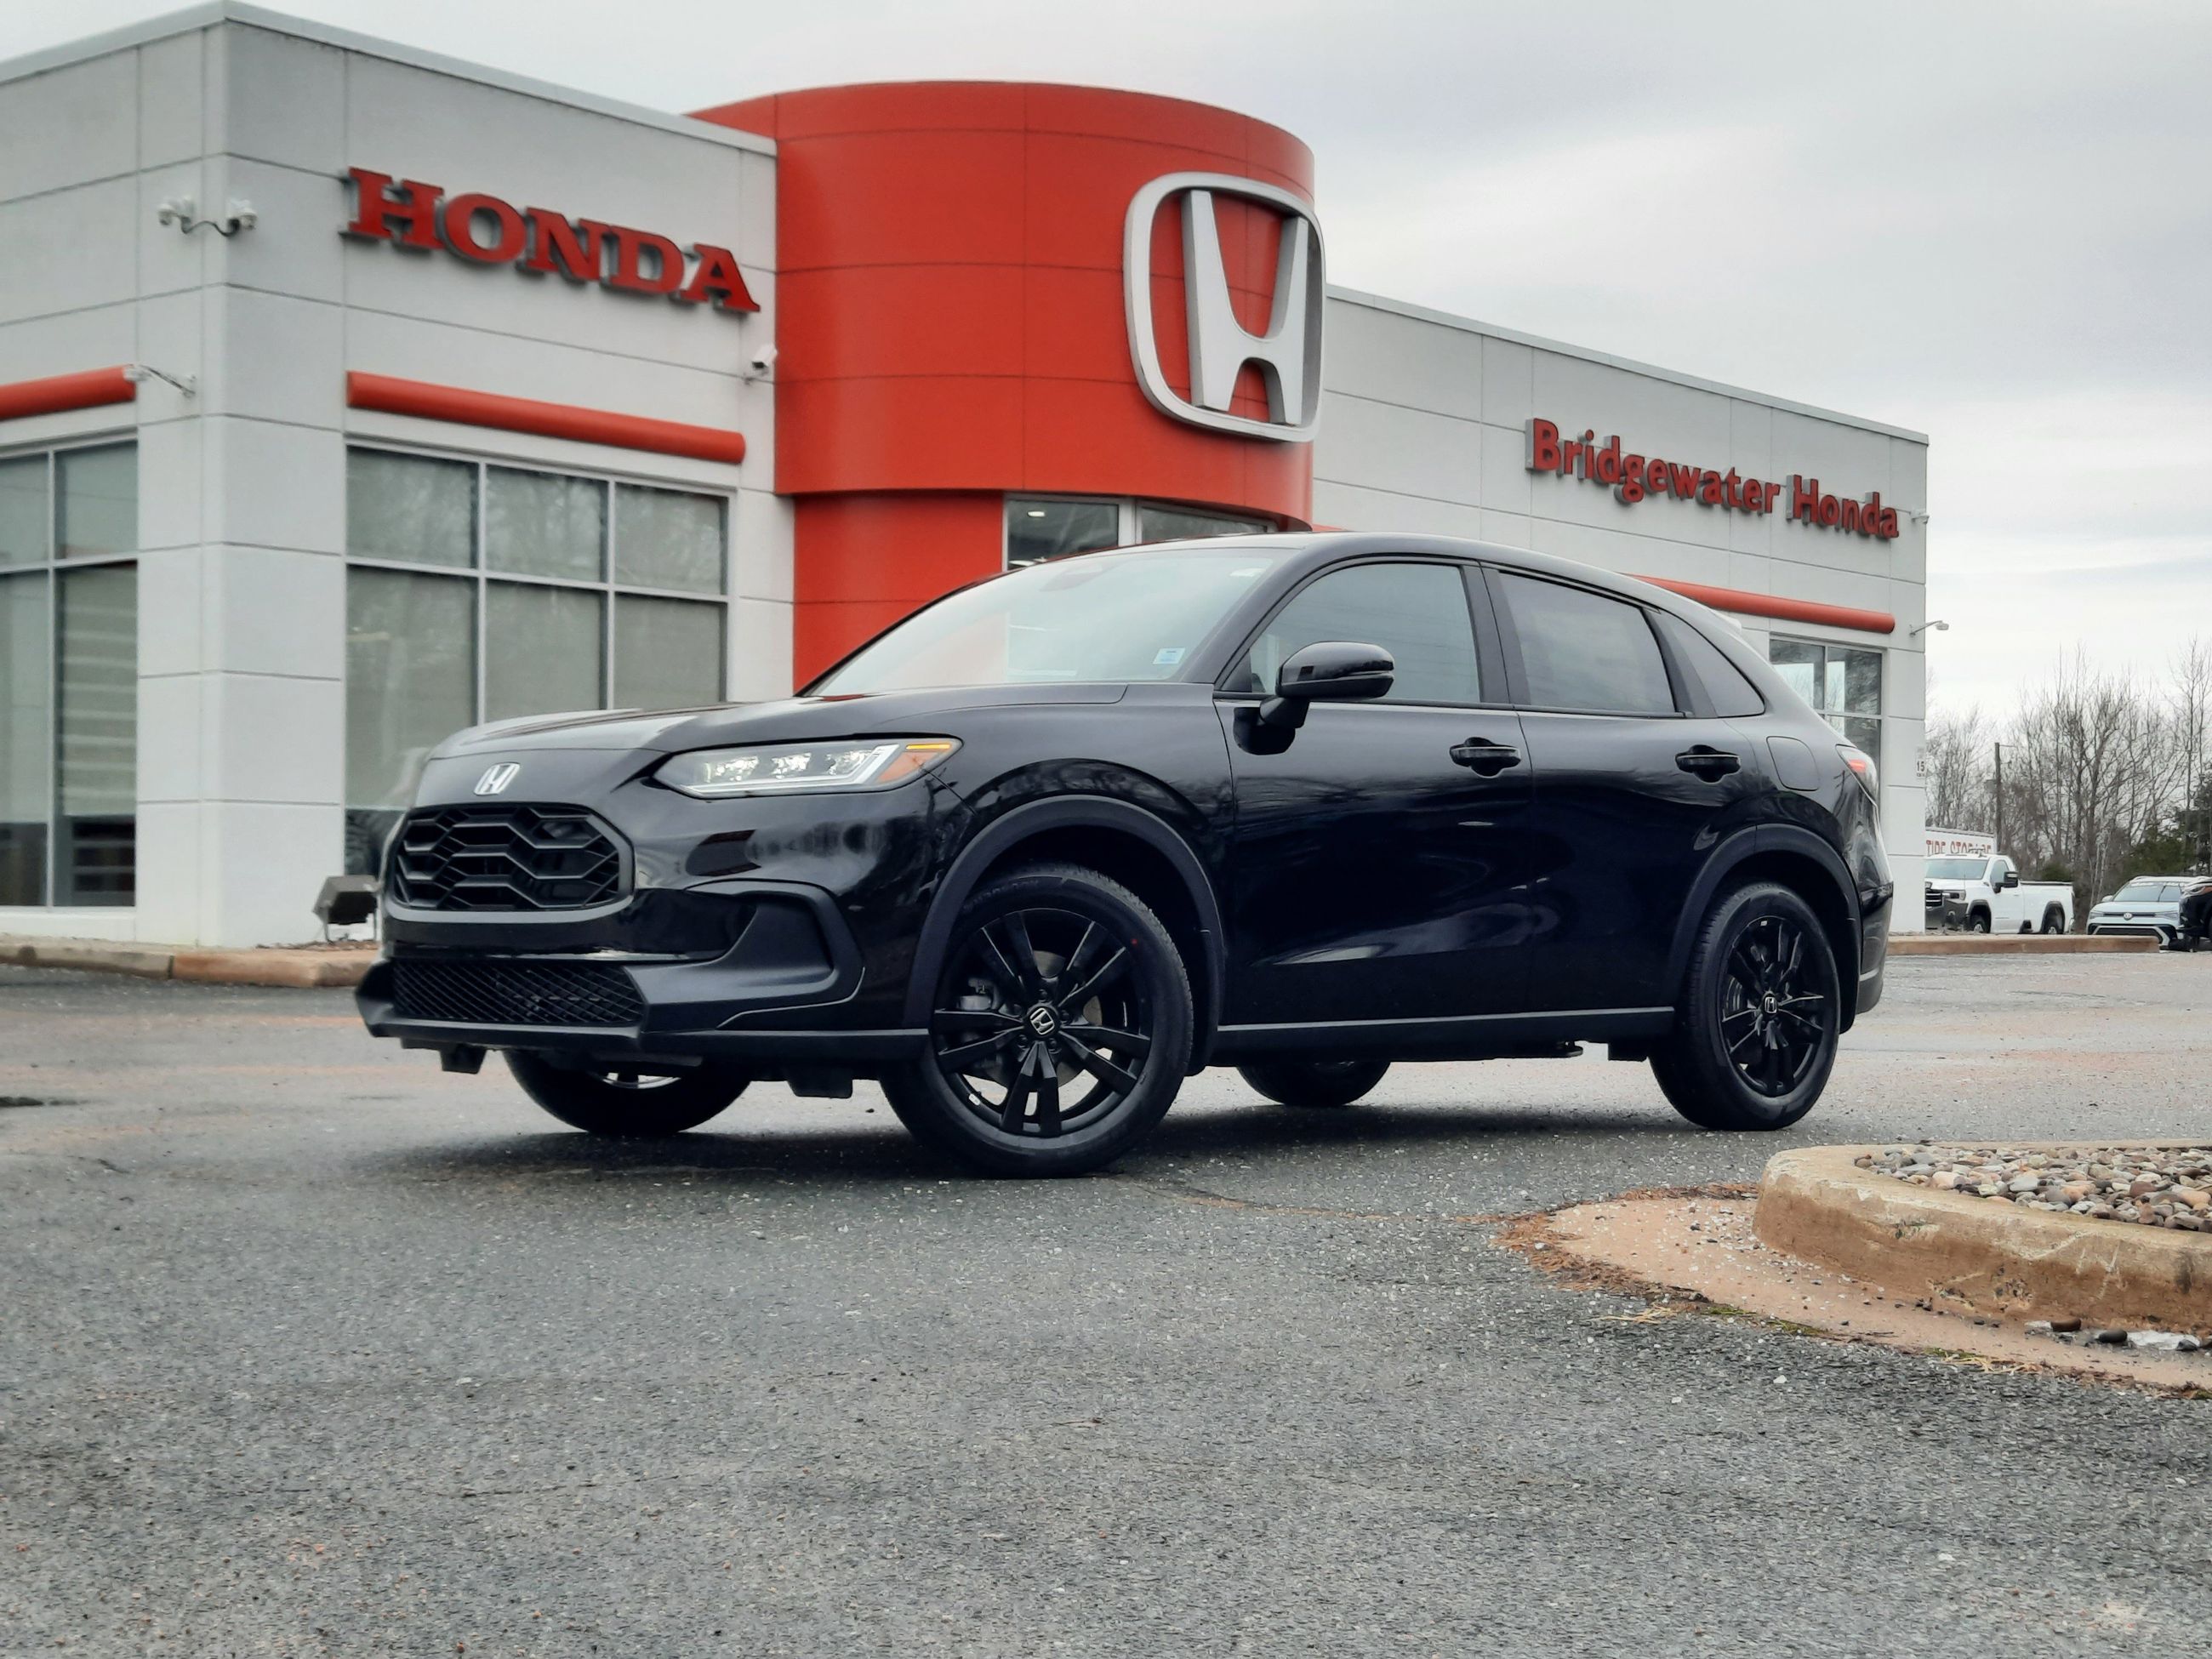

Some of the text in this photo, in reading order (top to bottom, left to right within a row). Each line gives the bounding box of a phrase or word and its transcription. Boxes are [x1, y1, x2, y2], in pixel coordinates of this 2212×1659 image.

[345, 167, 761, 313] HONDA
[1530, 418, 1900, 539] Bridgewater Honda
